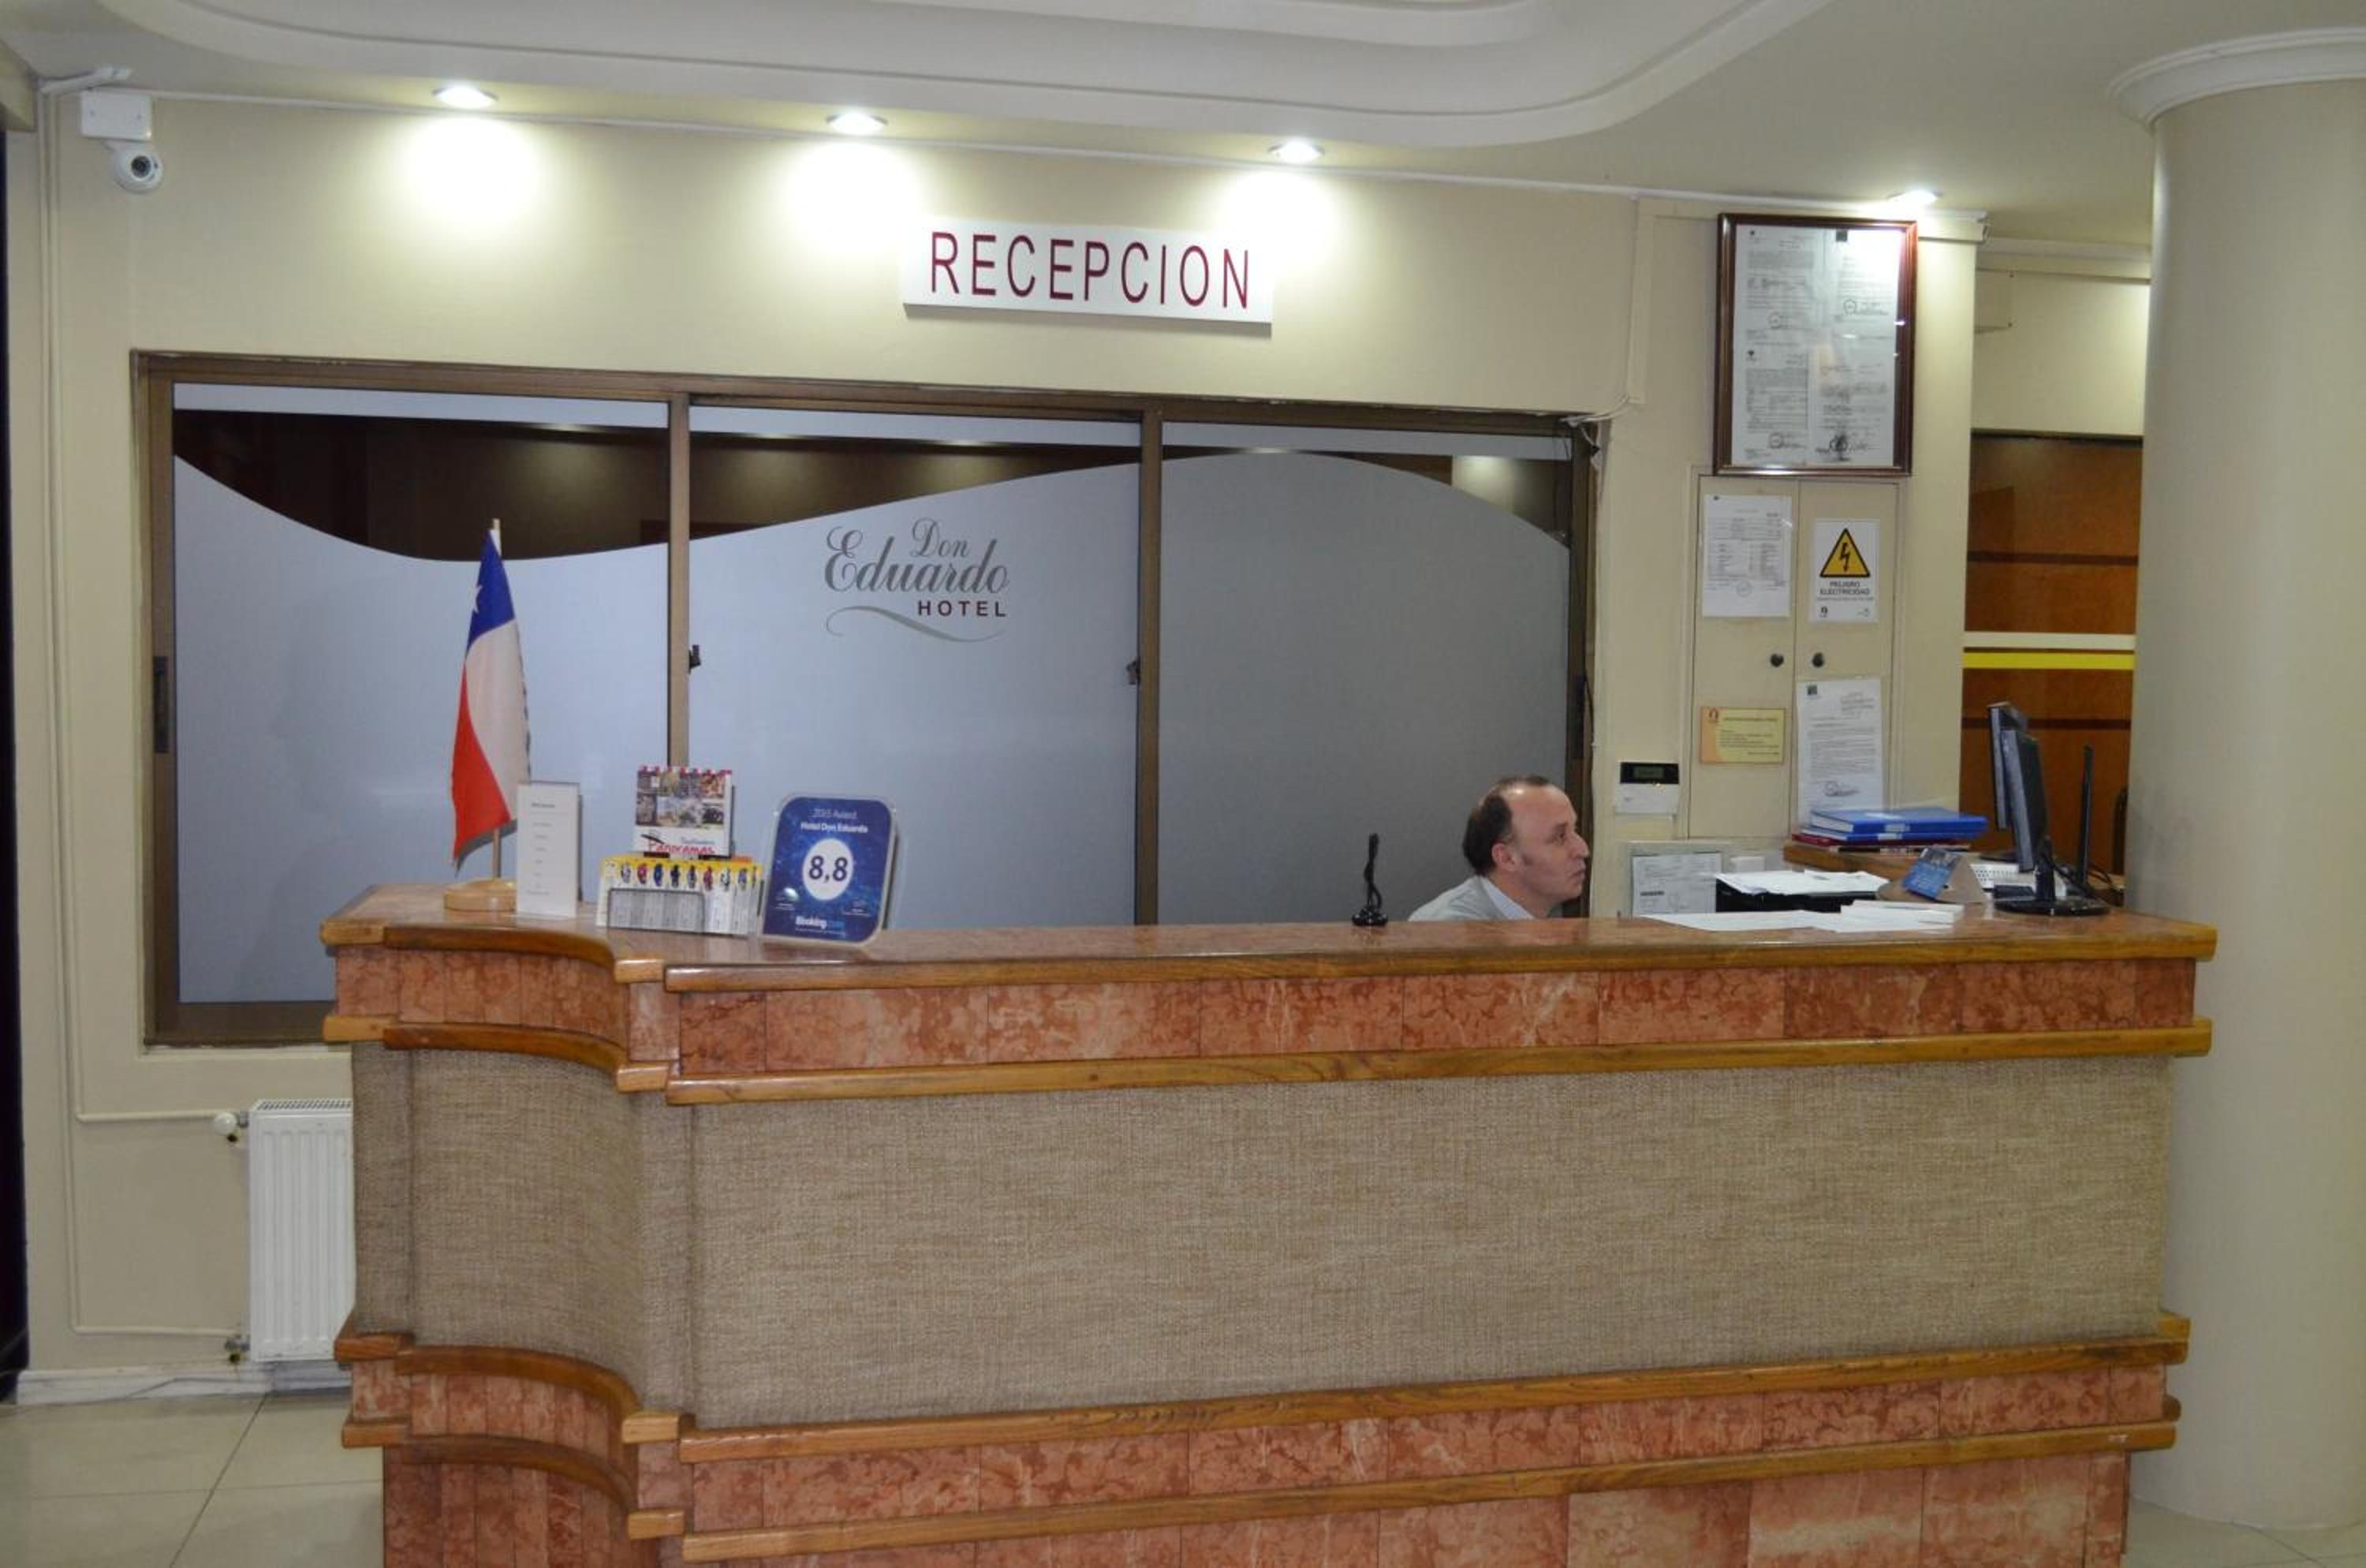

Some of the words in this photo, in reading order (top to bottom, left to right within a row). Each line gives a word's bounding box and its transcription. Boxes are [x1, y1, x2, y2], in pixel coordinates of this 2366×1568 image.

[930, 230, 1250, 310] RECEPCION
[910, 517, 970, 558] Don
[824, 525, 1010, 593] Eduardo
[917, 599, 1006, 618] HOTEL
[800, 821, 821, 831] Hotel
[808, 855, 848, 883] 8,8
